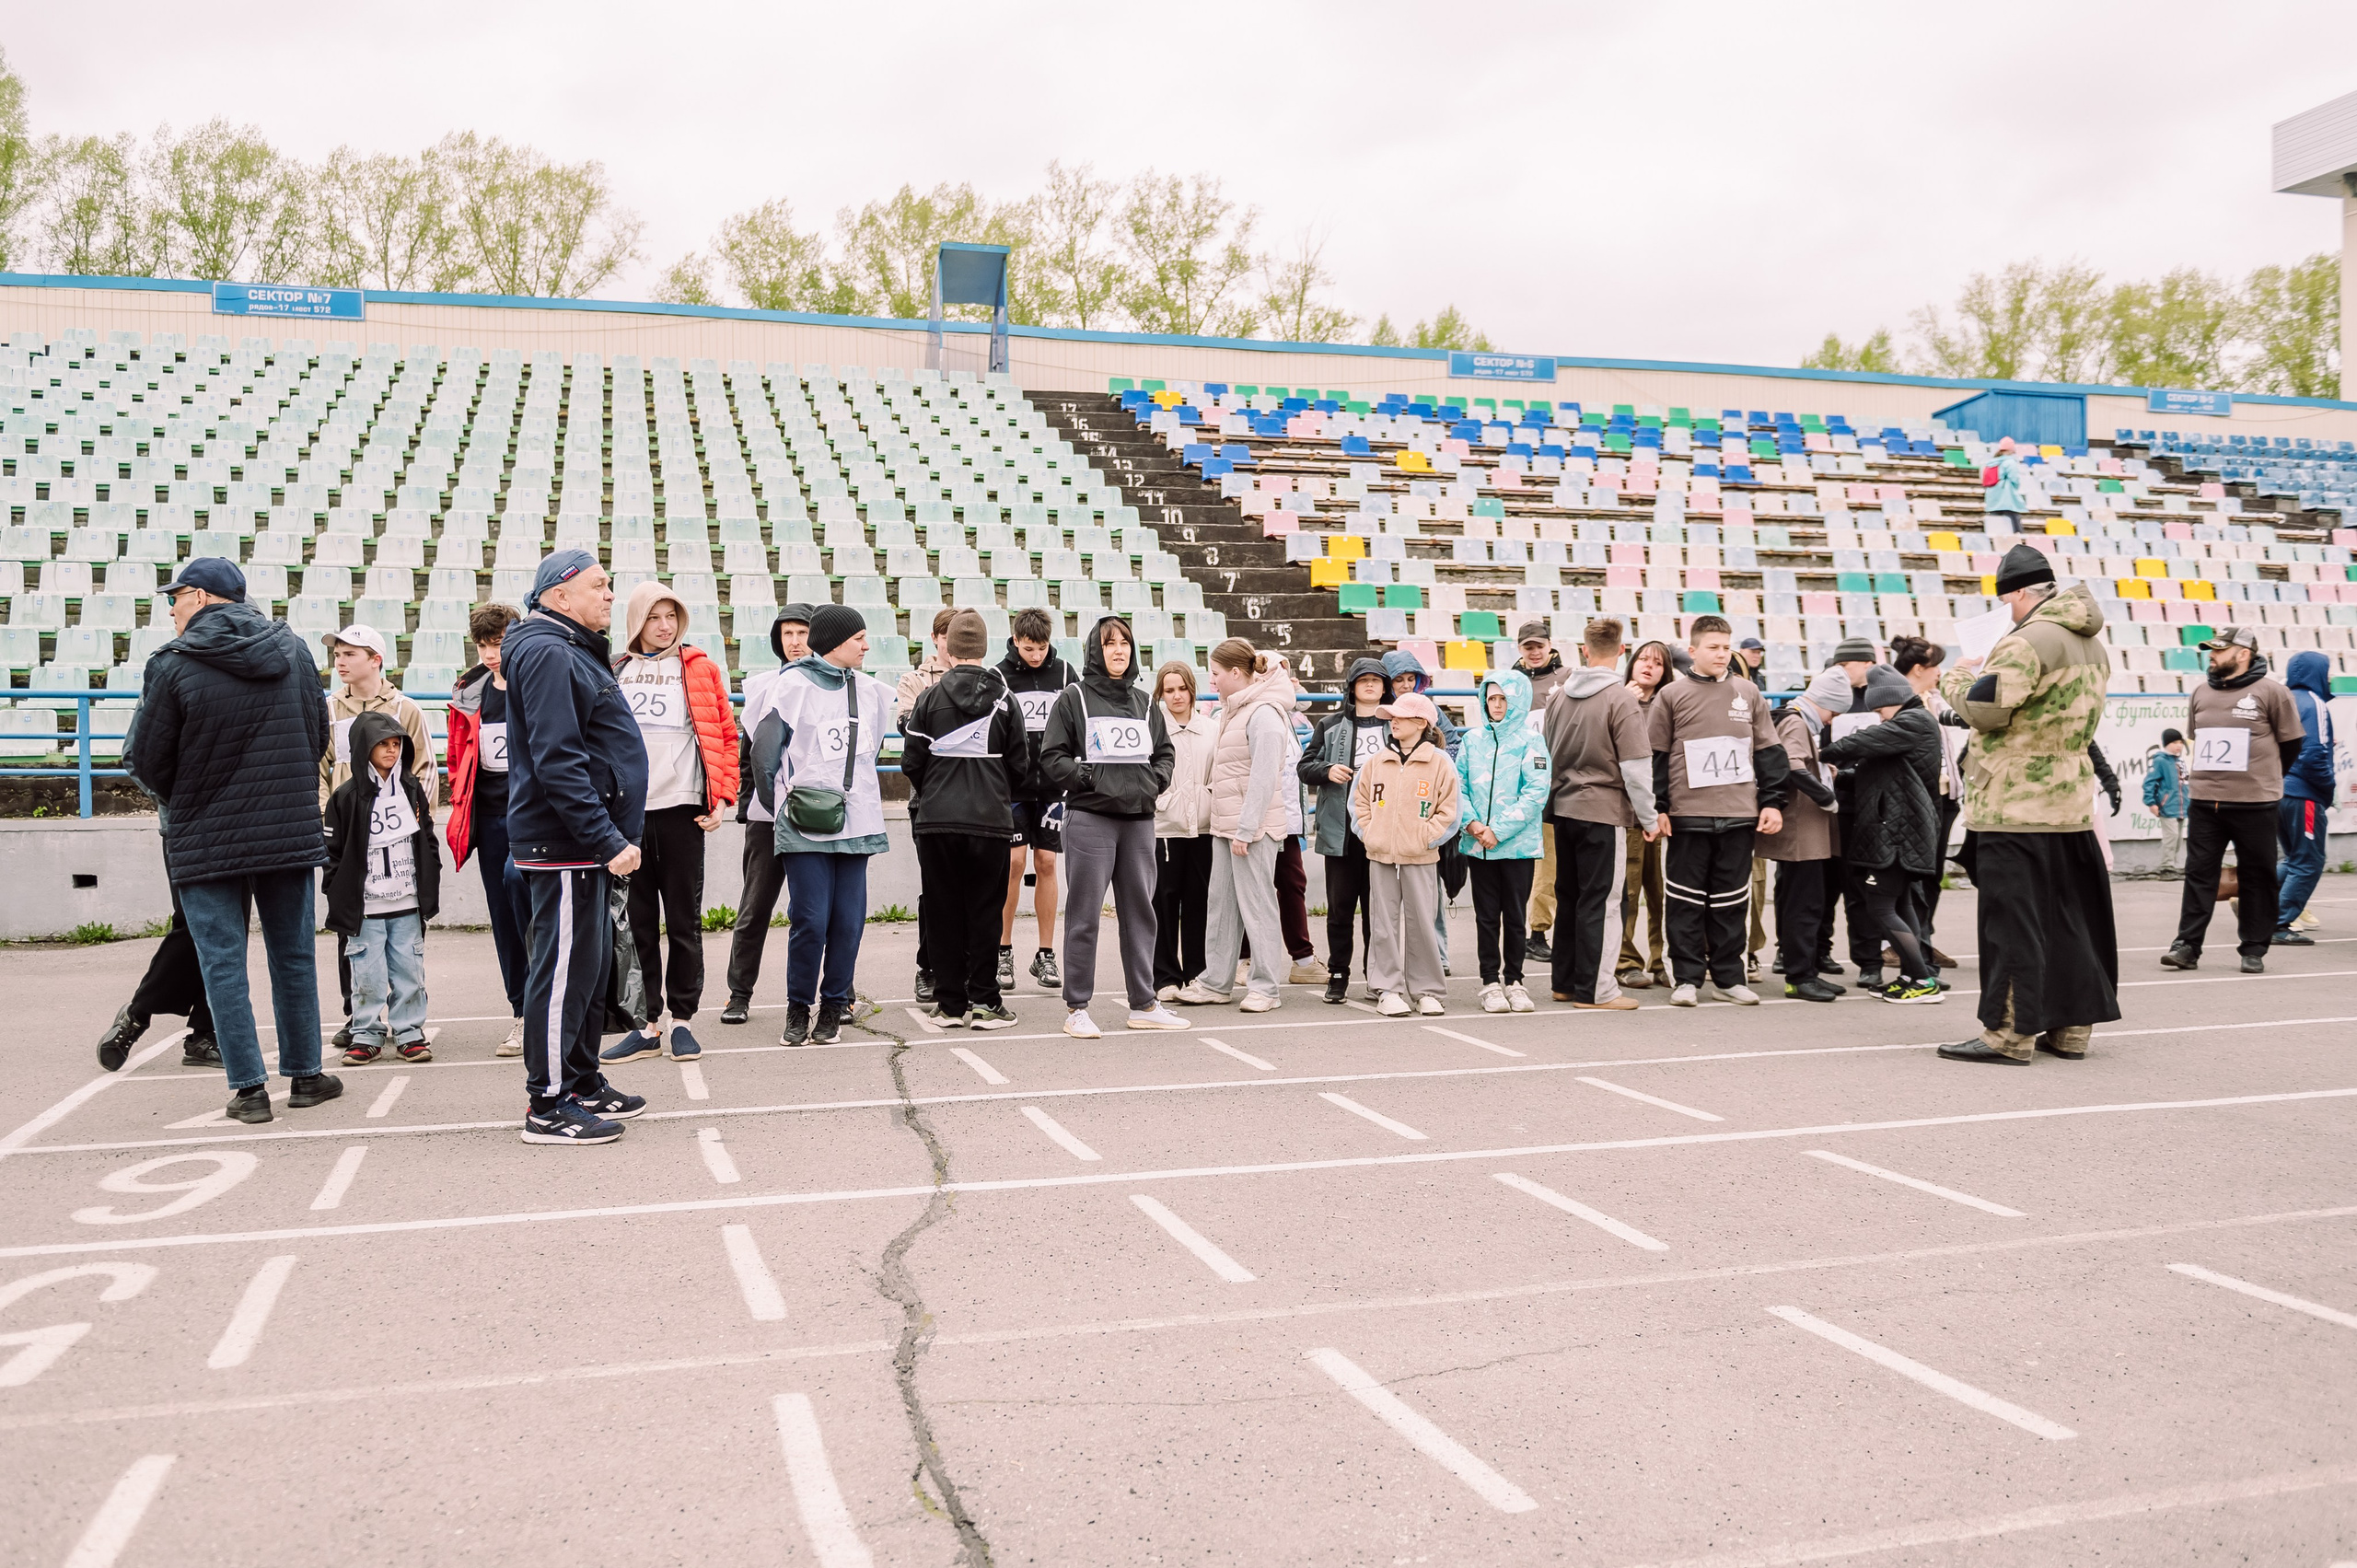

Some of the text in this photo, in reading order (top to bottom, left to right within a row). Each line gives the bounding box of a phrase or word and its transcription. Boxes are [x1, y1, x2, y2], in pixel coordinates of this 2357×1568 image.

[248, 289, 304, 302] СЕКТОР
[1473, 356, 1515, 367] СЕКТОР
[1061, 402, 1077, 412] 17
[1071, 418, 1089, 429] 16
[1125, 473, 1144, 487] 12
[1144, 491, 1164, 505] 11
[1161, 508, 1183, 524] 10
[1182, 528, 1195, 542] 9
[1224, 572, 1237, 592] 7
[1247, 598, 1261, 620] 6
[1299, 655, 1315, 677] 4
[633, 691, 667, 717] 25
[1023, 701, 1049, 720] 24
[2116, 701, 2189, 727] футболо
[1110, 726, 1141, 749] 29
[1338, 729, 1348, 764] THLAND
[1355, 735, 1380, 756] 28
[2200, 739, 2232, 764] 42
[1701, 749, 1740, 778] 44
[1372, 783, 1385, 803] R
[1417, 780, 1430, 797] B
[1419, 800, 1432, 819] K
